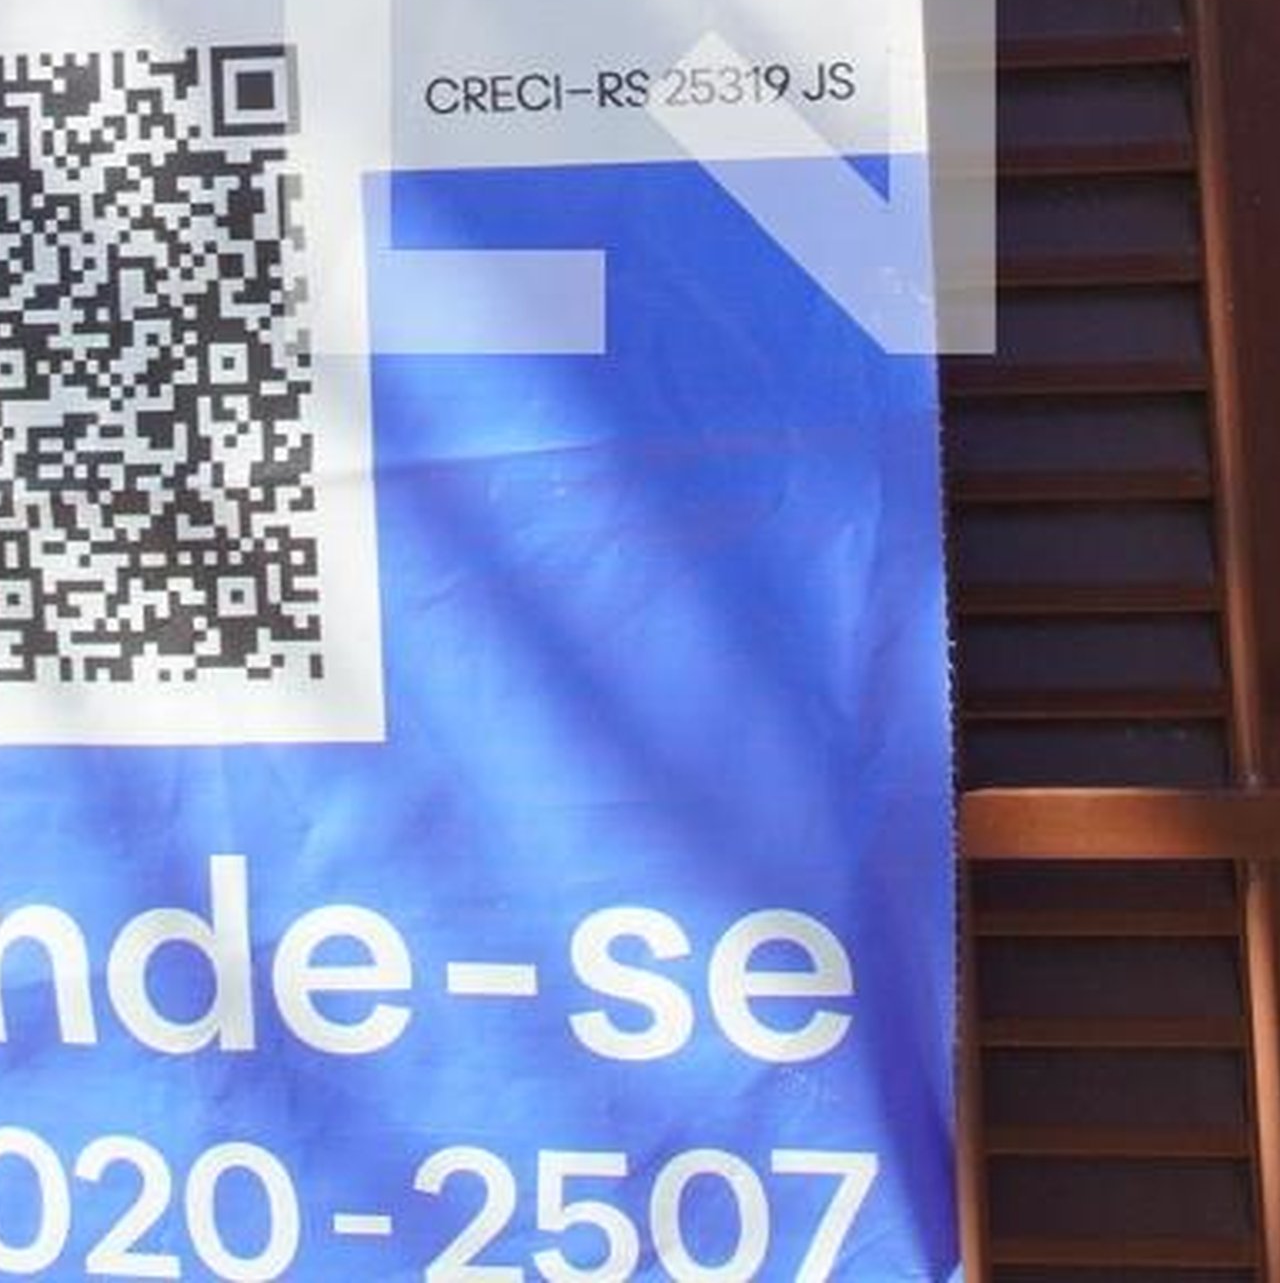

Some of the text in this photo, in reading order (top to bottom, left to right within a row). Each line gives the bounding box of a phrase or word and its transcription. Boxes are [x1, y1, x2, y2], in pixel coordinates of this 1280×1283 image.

[425, 61, 856, 114] CRECI-RS 25319 JS
